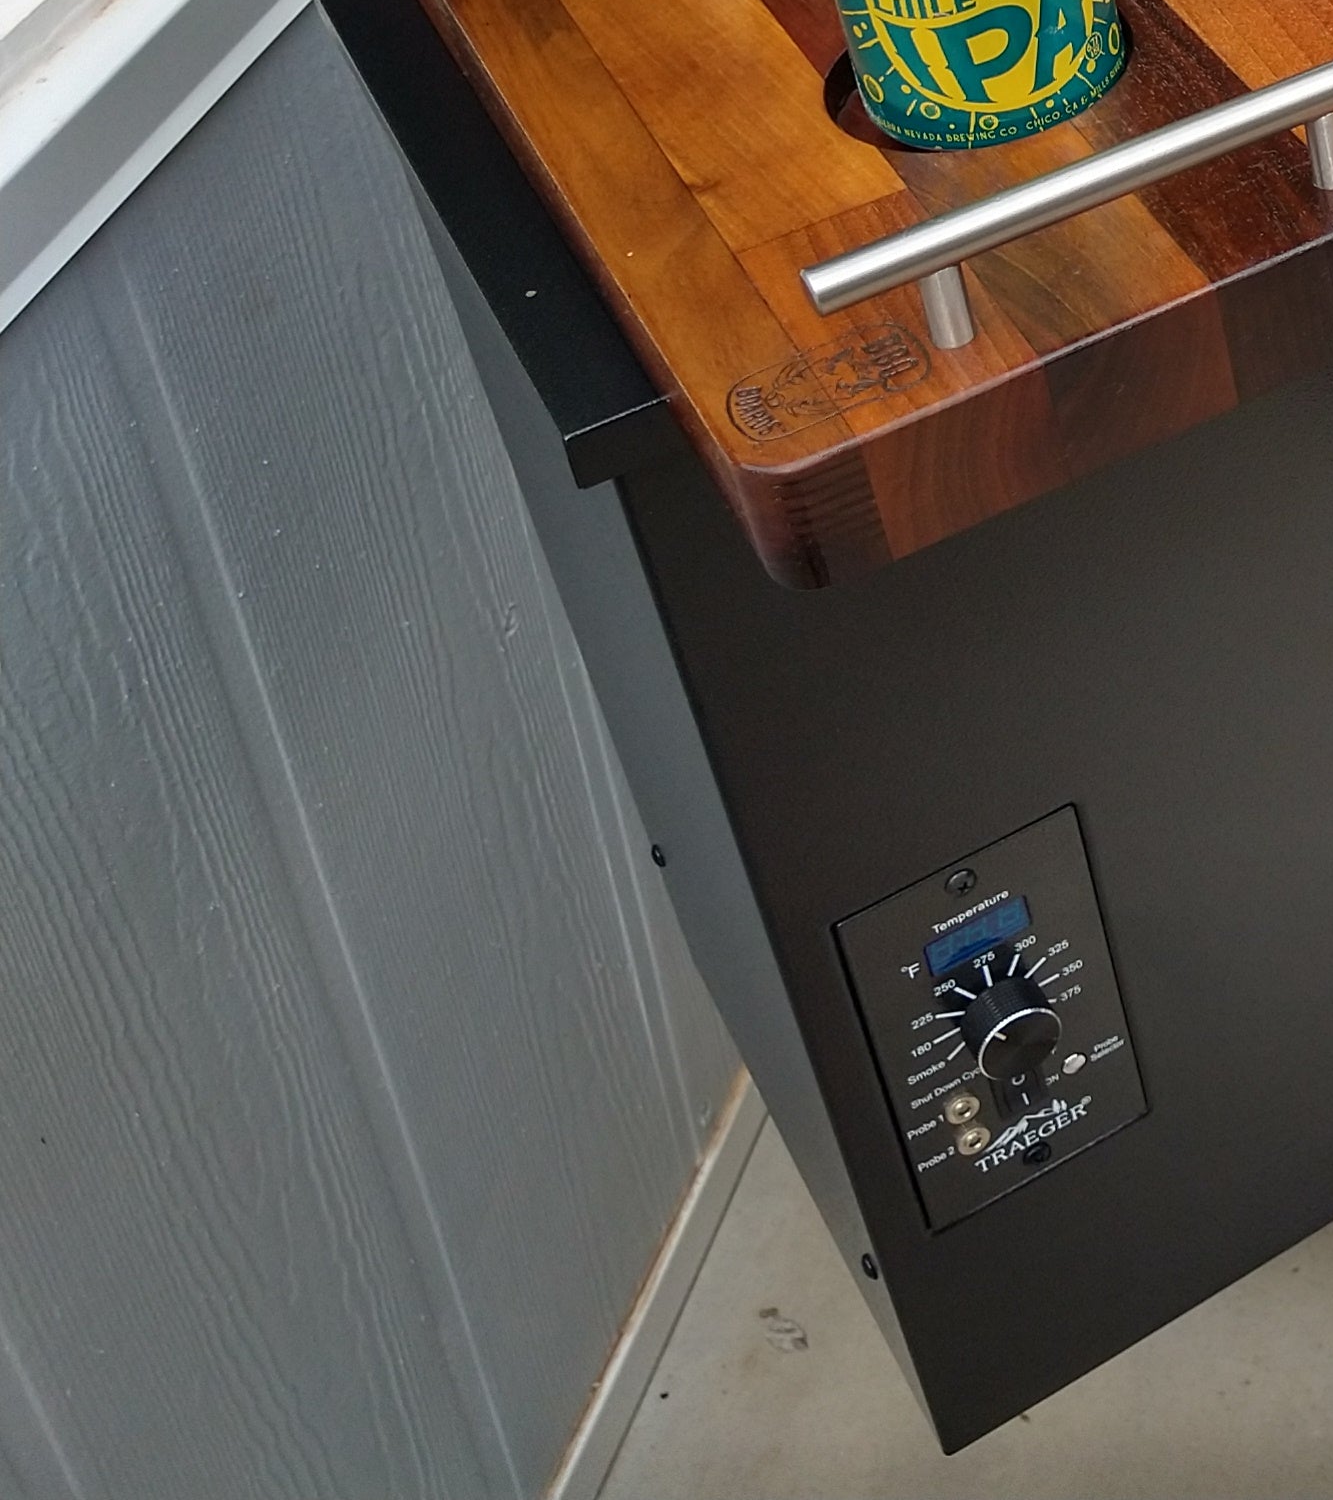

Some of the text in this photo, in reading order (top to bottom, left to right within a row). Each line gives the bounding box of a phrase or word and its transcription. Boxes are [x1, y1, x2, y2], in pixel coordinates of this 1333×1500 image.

[904, 128, 943, 142] NEVADA
[945, 130, 996, 143] BREWING
[999, 125, 1018, 137] CO
[1065, 101, 1078, 115] CA
[931, 890, 1010, 935] Temperature
[1014, 934, 1037, 953] 300
[1048, 939, 1070, 958] 325
[972, 952, 996, 970] 275
[1061, 959, 1084, 977] 350
[933, 978, 957, 997] 250
[1060, 984, 1083, 1002] 375
[910, 1012, 934, 1031] 225
[911, 1041, 933, 1059] 180
[907, 1060, 947, 1086] Smoke
[910, 1091, 935, 1110] Shut
[936, 1076, 962, 1098] Down
[906, 1119, 939, 1141] Probe
[974, 1102, 1088, 1173] TRAEGER
[917, 1146, 955, 1173] Probe 2
